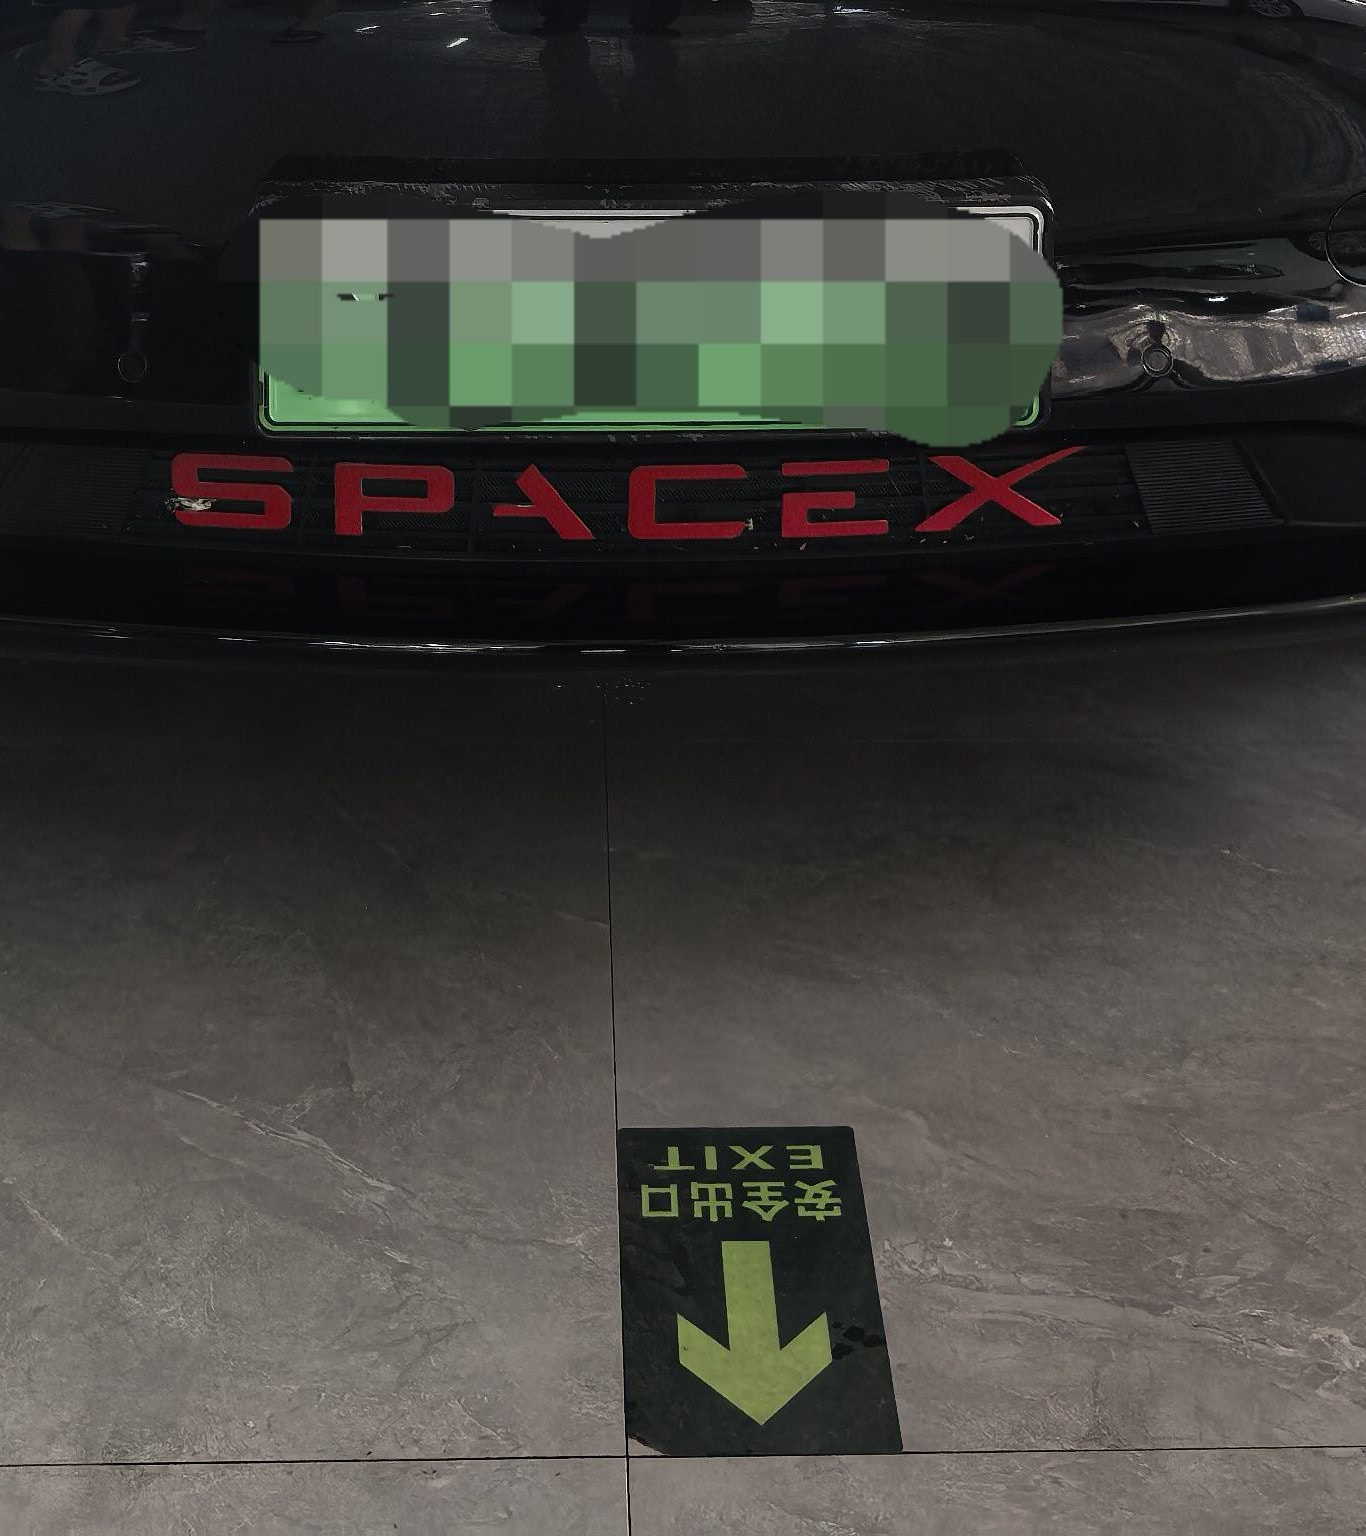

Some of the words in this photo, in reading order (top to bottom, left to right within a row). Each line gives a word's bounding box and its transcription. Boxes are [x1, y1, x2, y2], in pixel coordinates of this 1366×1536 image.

[168, 445, 1087, 541] SPACEX
[652, 1144, 824, 1171] EXIT
[640, 1179, 842, 1222] 安全出口
